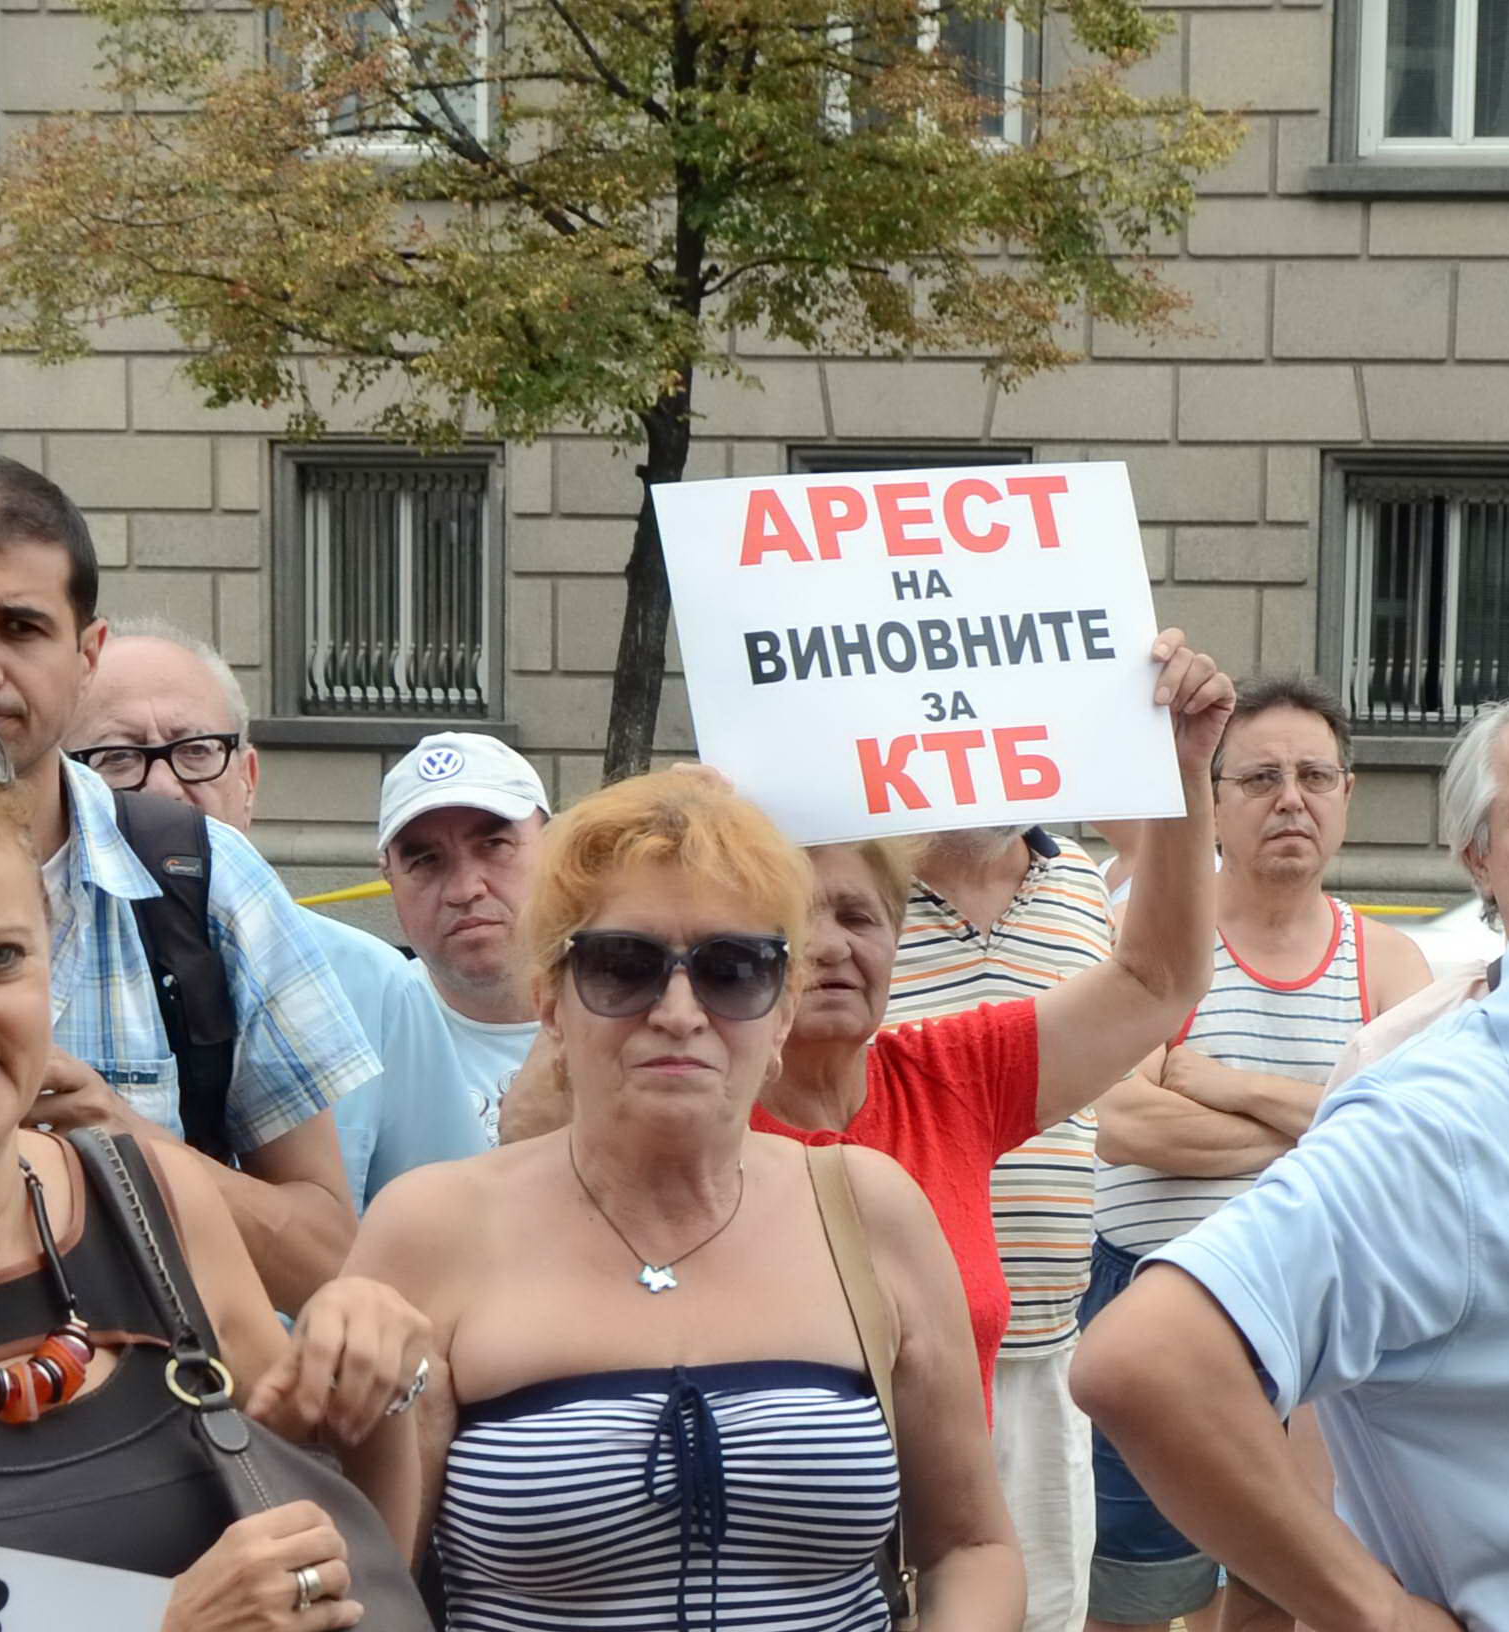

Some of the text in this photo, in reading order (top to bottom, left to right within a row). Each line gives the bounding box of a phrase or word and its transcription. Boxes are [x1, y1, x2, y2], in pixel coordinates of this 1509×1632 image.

[740, 475, 1069, 567] АРЕСТ
[891, 570, 953, 601] НА
[743, 609, 1116, 686] ВИНОВНИТЕ
[921, 690, 978, 723] ЗА
[856, 724, 1061, 815] КТБ
